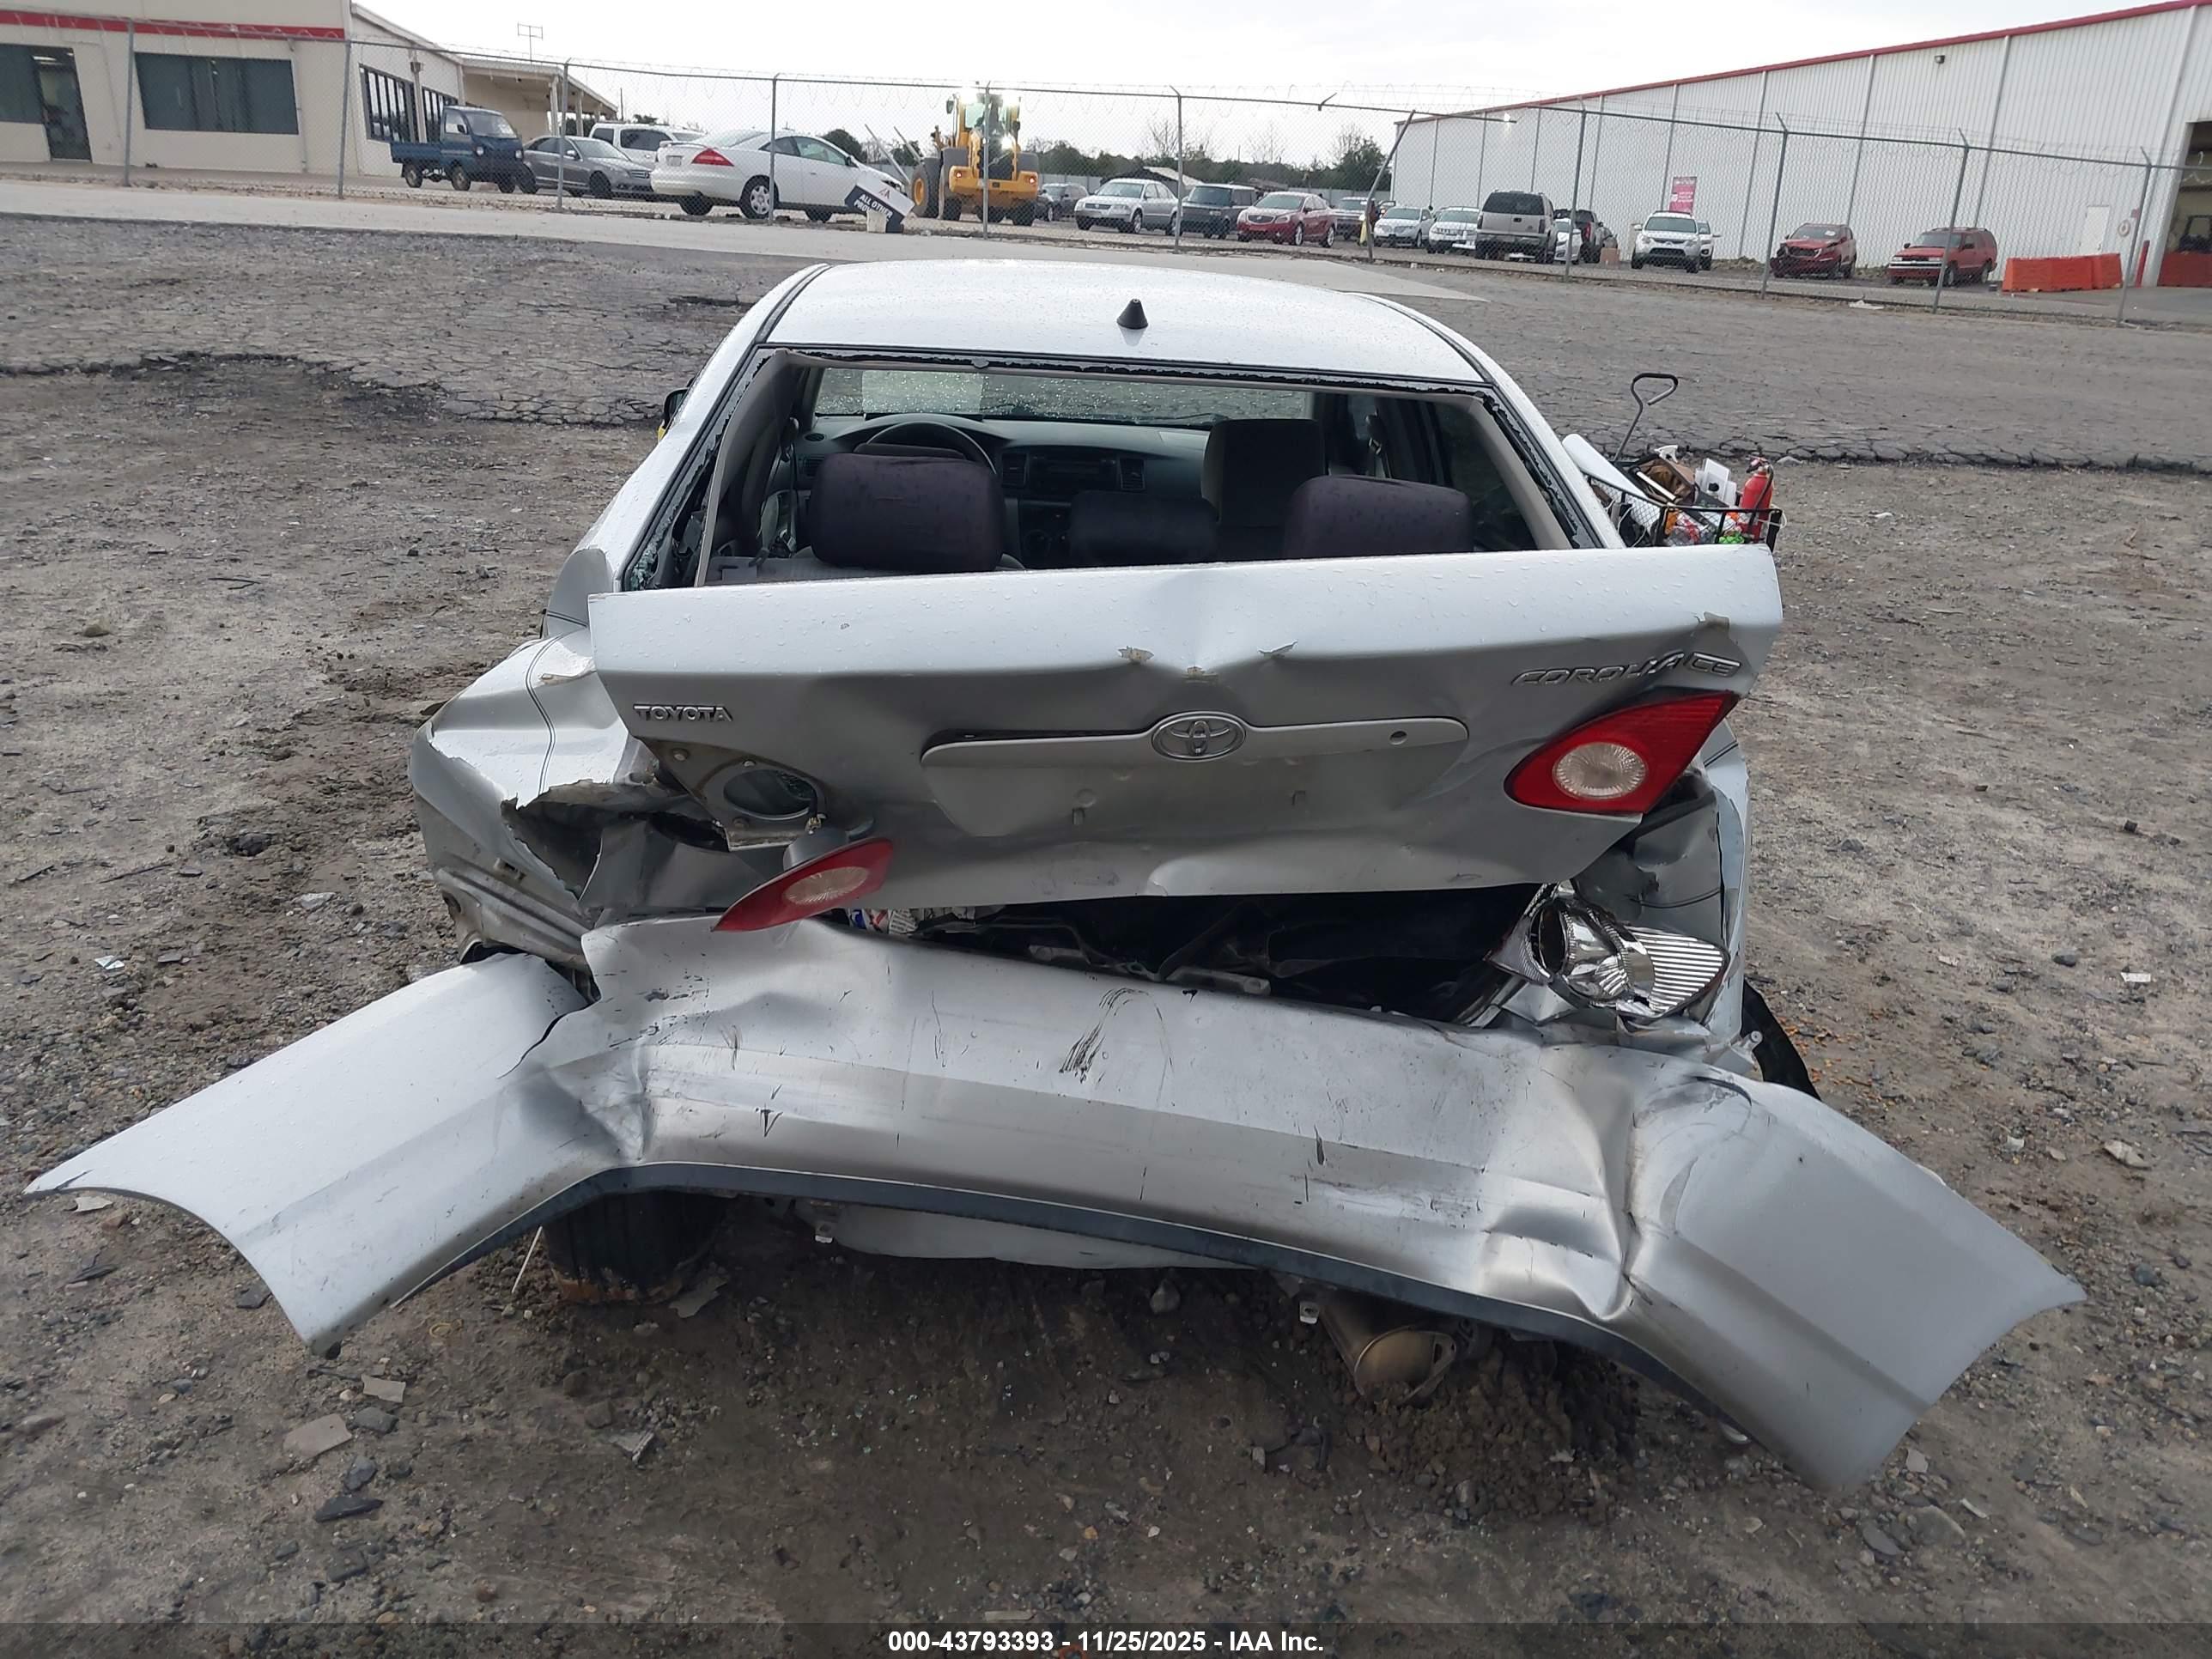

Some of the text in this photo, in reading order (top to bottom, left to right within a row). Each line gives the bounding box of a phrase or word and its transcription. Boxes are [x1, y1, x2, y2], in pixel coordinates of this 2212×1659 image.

[859, 193, 872, 205] ALL
[872, 201, 893, 218] OTHER
[633, 703, 733, 722] TOYOTA
